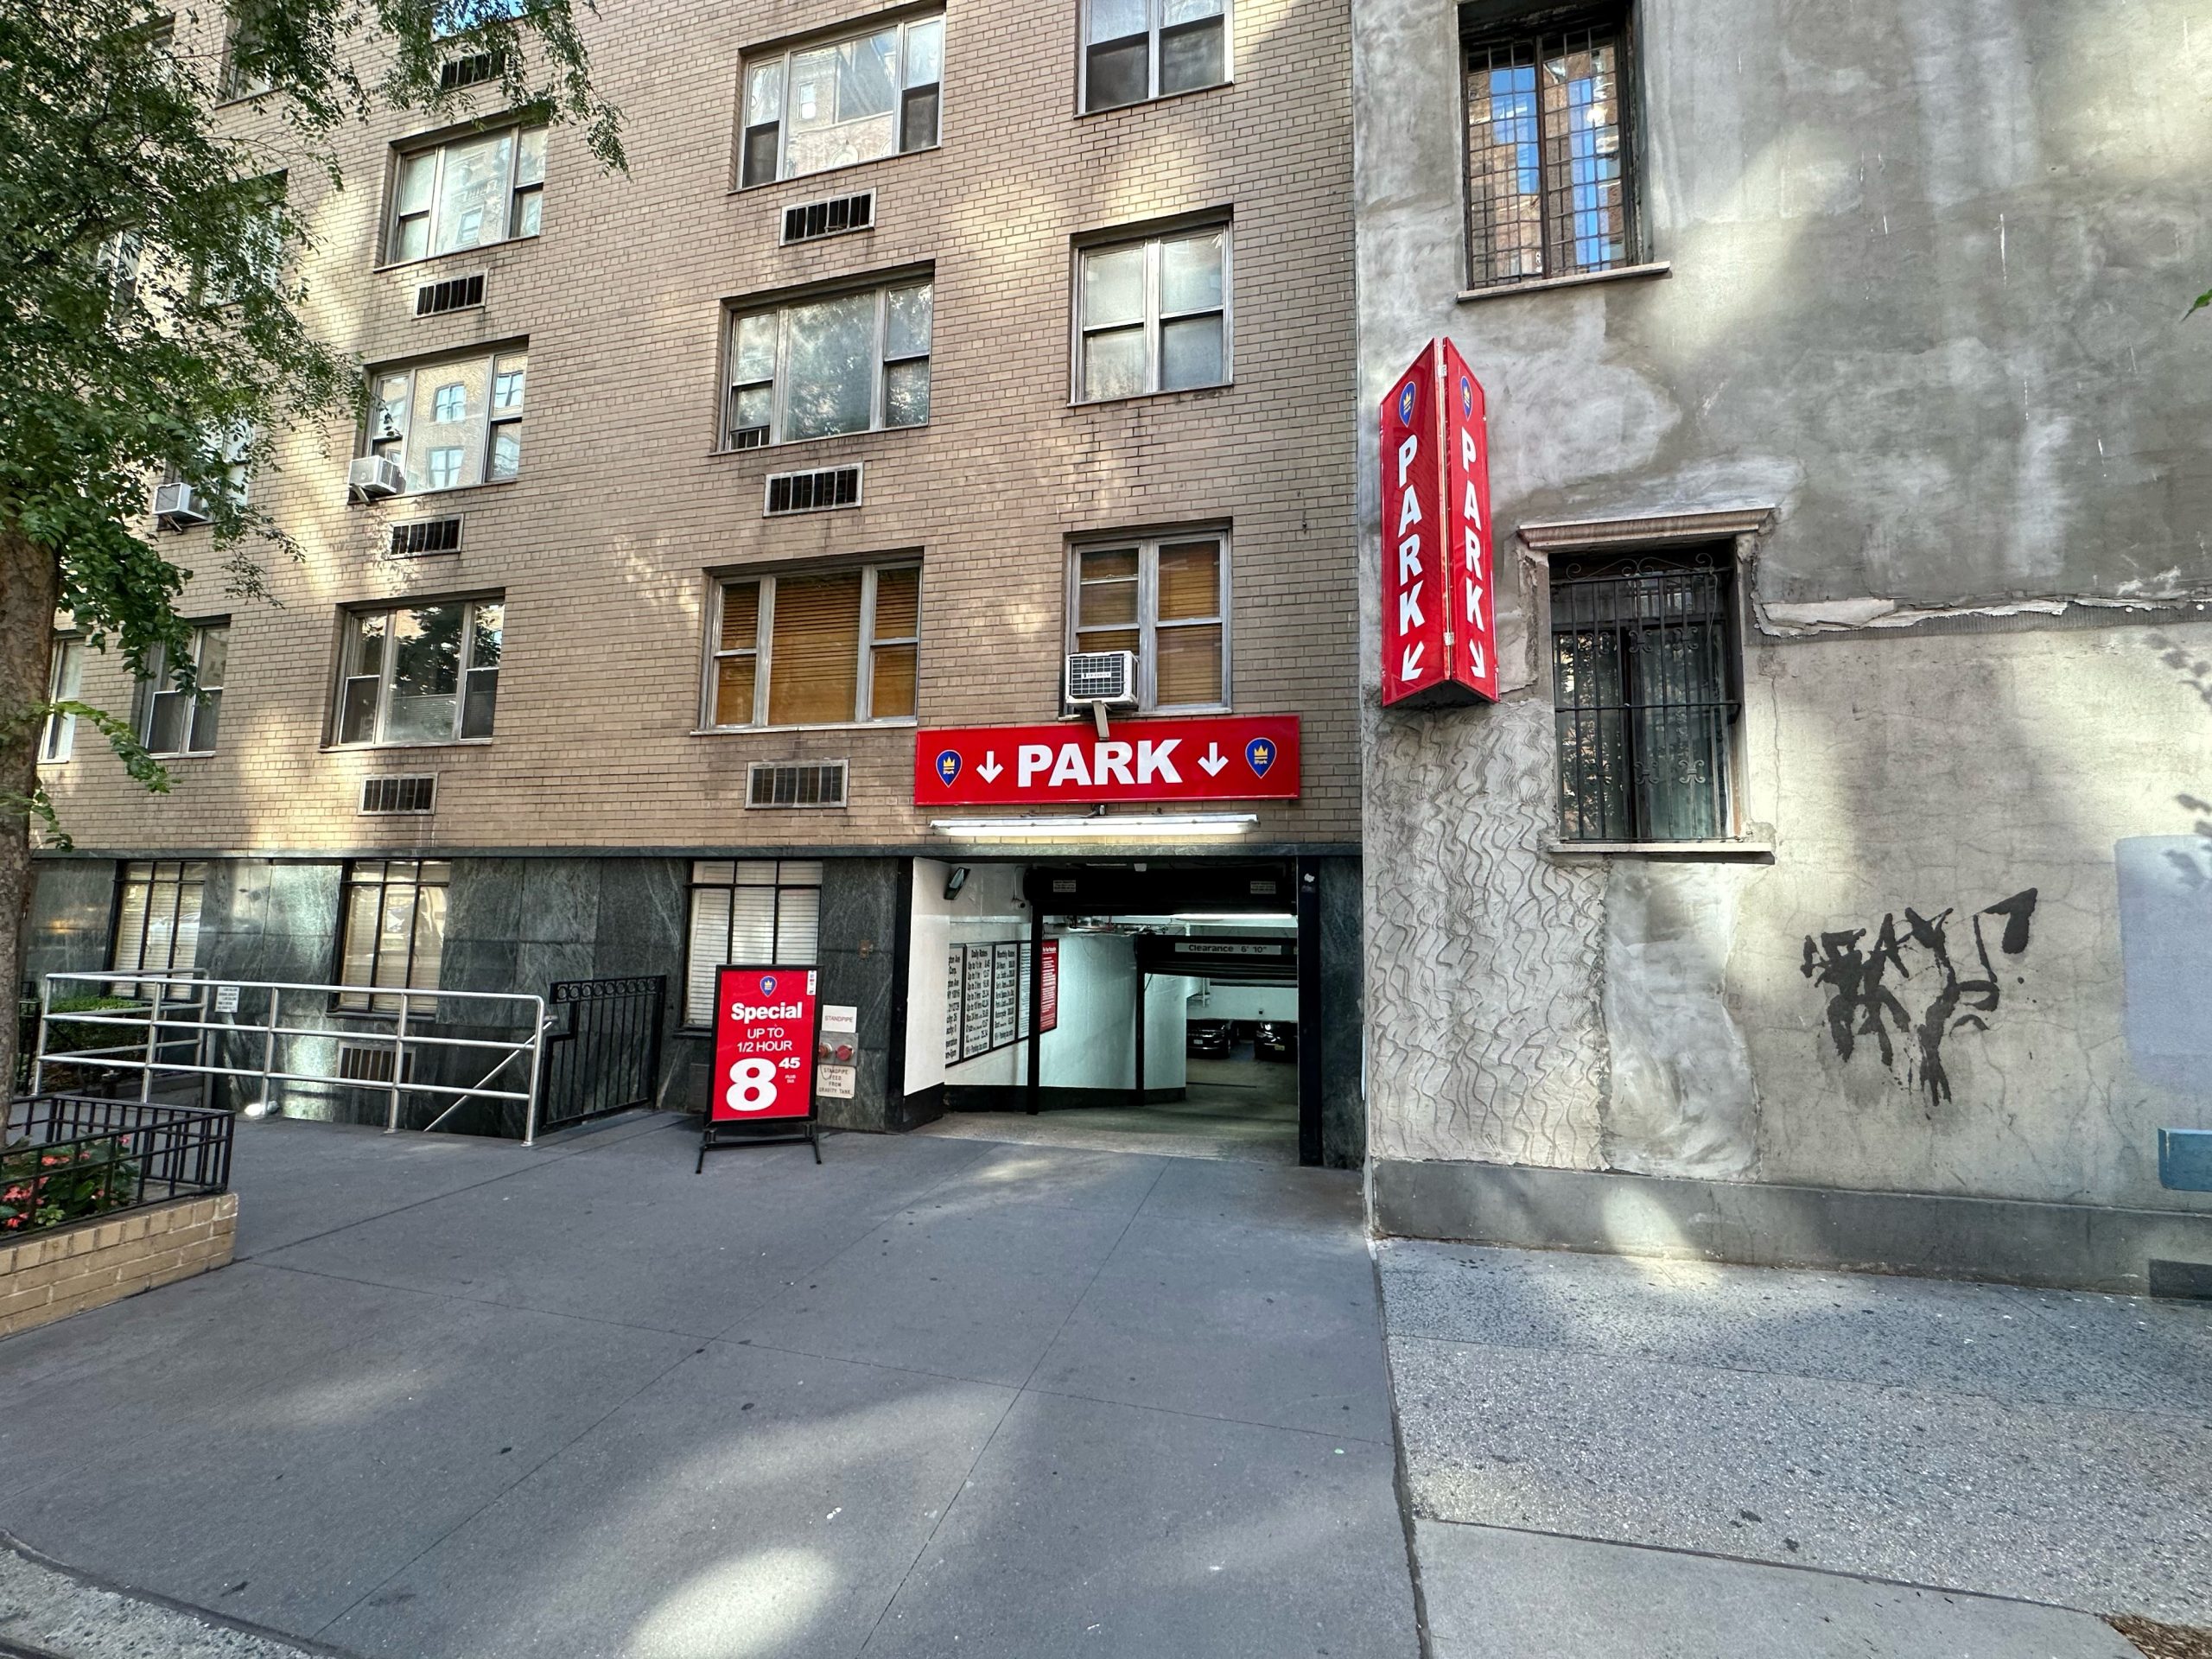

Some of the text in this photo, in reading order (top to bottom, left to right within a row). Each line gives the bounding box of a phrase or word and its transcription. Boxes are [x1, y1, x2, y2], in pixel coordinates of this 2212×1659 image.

[1398, 434, 1425, 637] PARK
[1461, 427, 1484, 632] PARK
[1018, 739, 1183, 787] PARK
[1188, 944, 1234, 953] Clearance
[731, 1001, 803, 1024] Special
[737, 1040, 792, 1052] 1/2 HOUR
[747, 1027, 785, 1039] UP TO
[726, 1057, 801, 1111] 8 45
